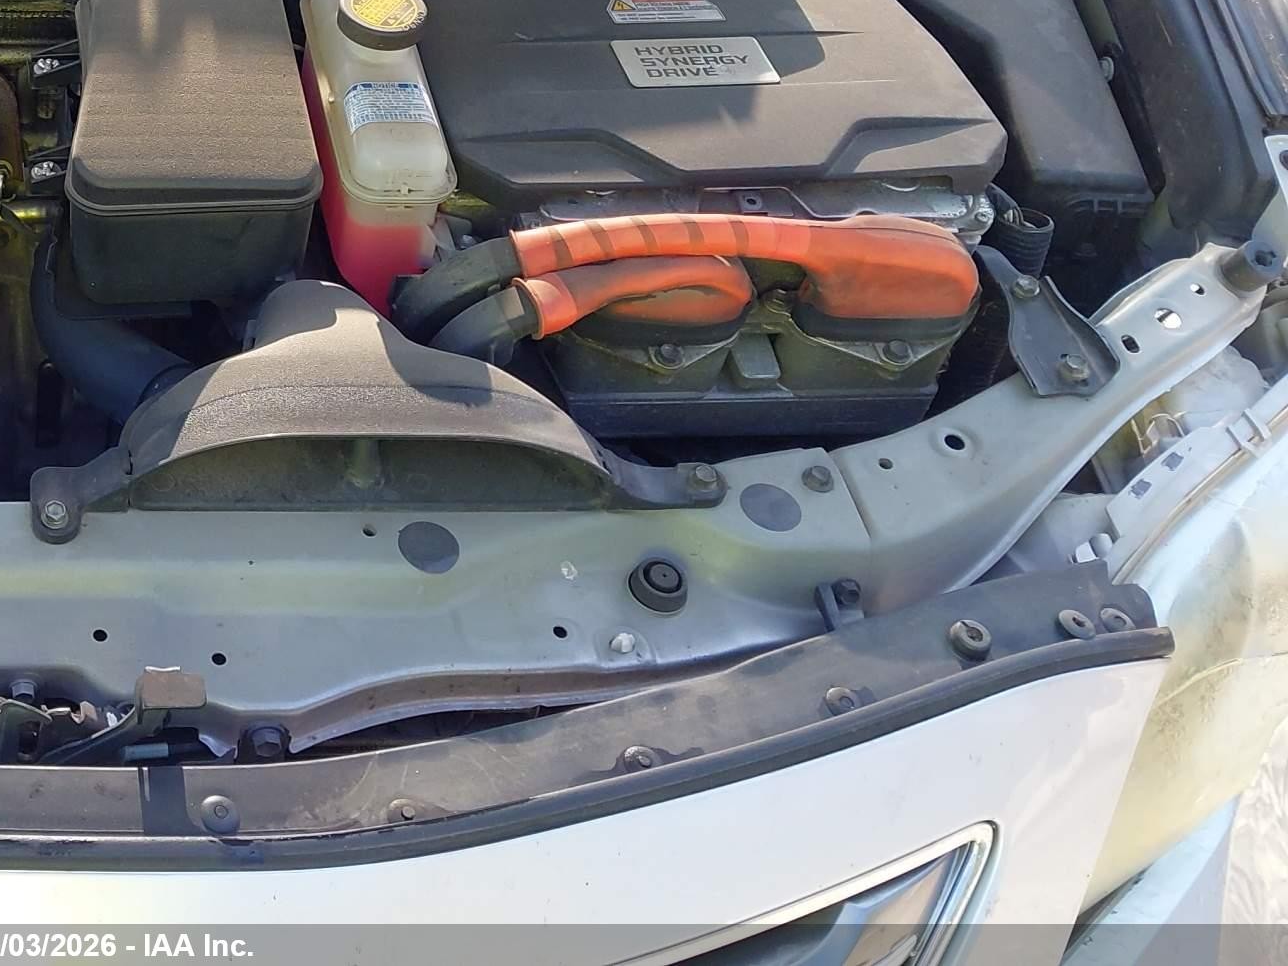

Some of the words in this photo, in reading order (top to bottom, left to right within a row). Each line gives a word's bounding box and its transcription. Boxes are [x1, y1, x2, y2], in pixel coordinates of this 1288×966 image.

[634, 44, 723, 56] HYBRID
[639, 54, 749, 67] SYNERGY
[646, 66, 719, 78] DRIVE
